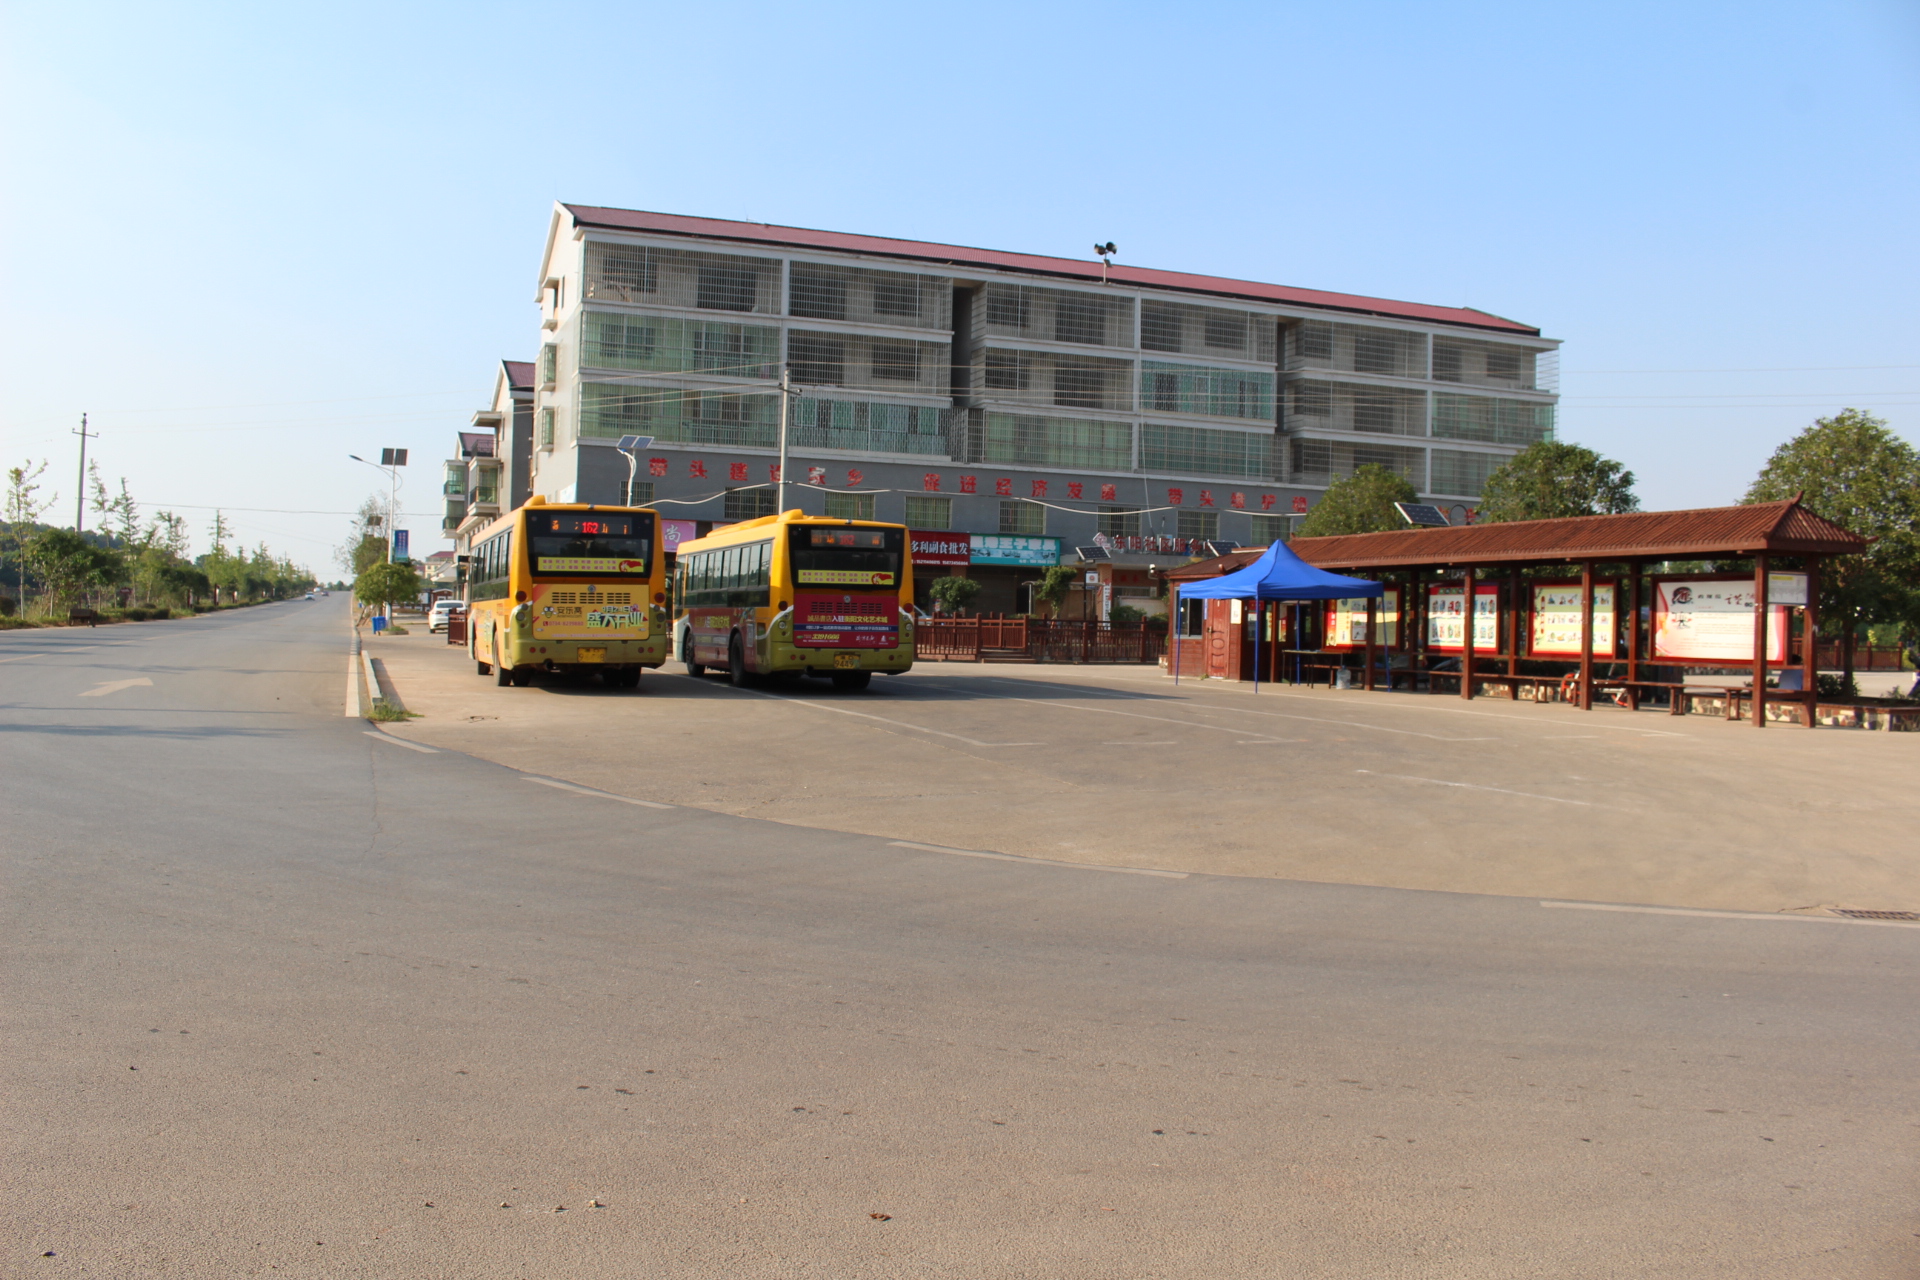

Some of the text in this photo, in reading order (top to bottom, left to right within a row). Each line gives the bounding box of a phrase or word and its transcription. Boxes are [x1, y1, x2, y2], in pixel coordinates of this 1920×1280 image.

[924, 473, 1117, 502] 促进经济发展
[581, 521, 599, 534] 162
[664, 524, 681, 543] 尚
[839, 534, 856, 546] 162
[911, 540, 968, 555] 多利副食批发
[586, 611, 645, 629] 盛大开业
